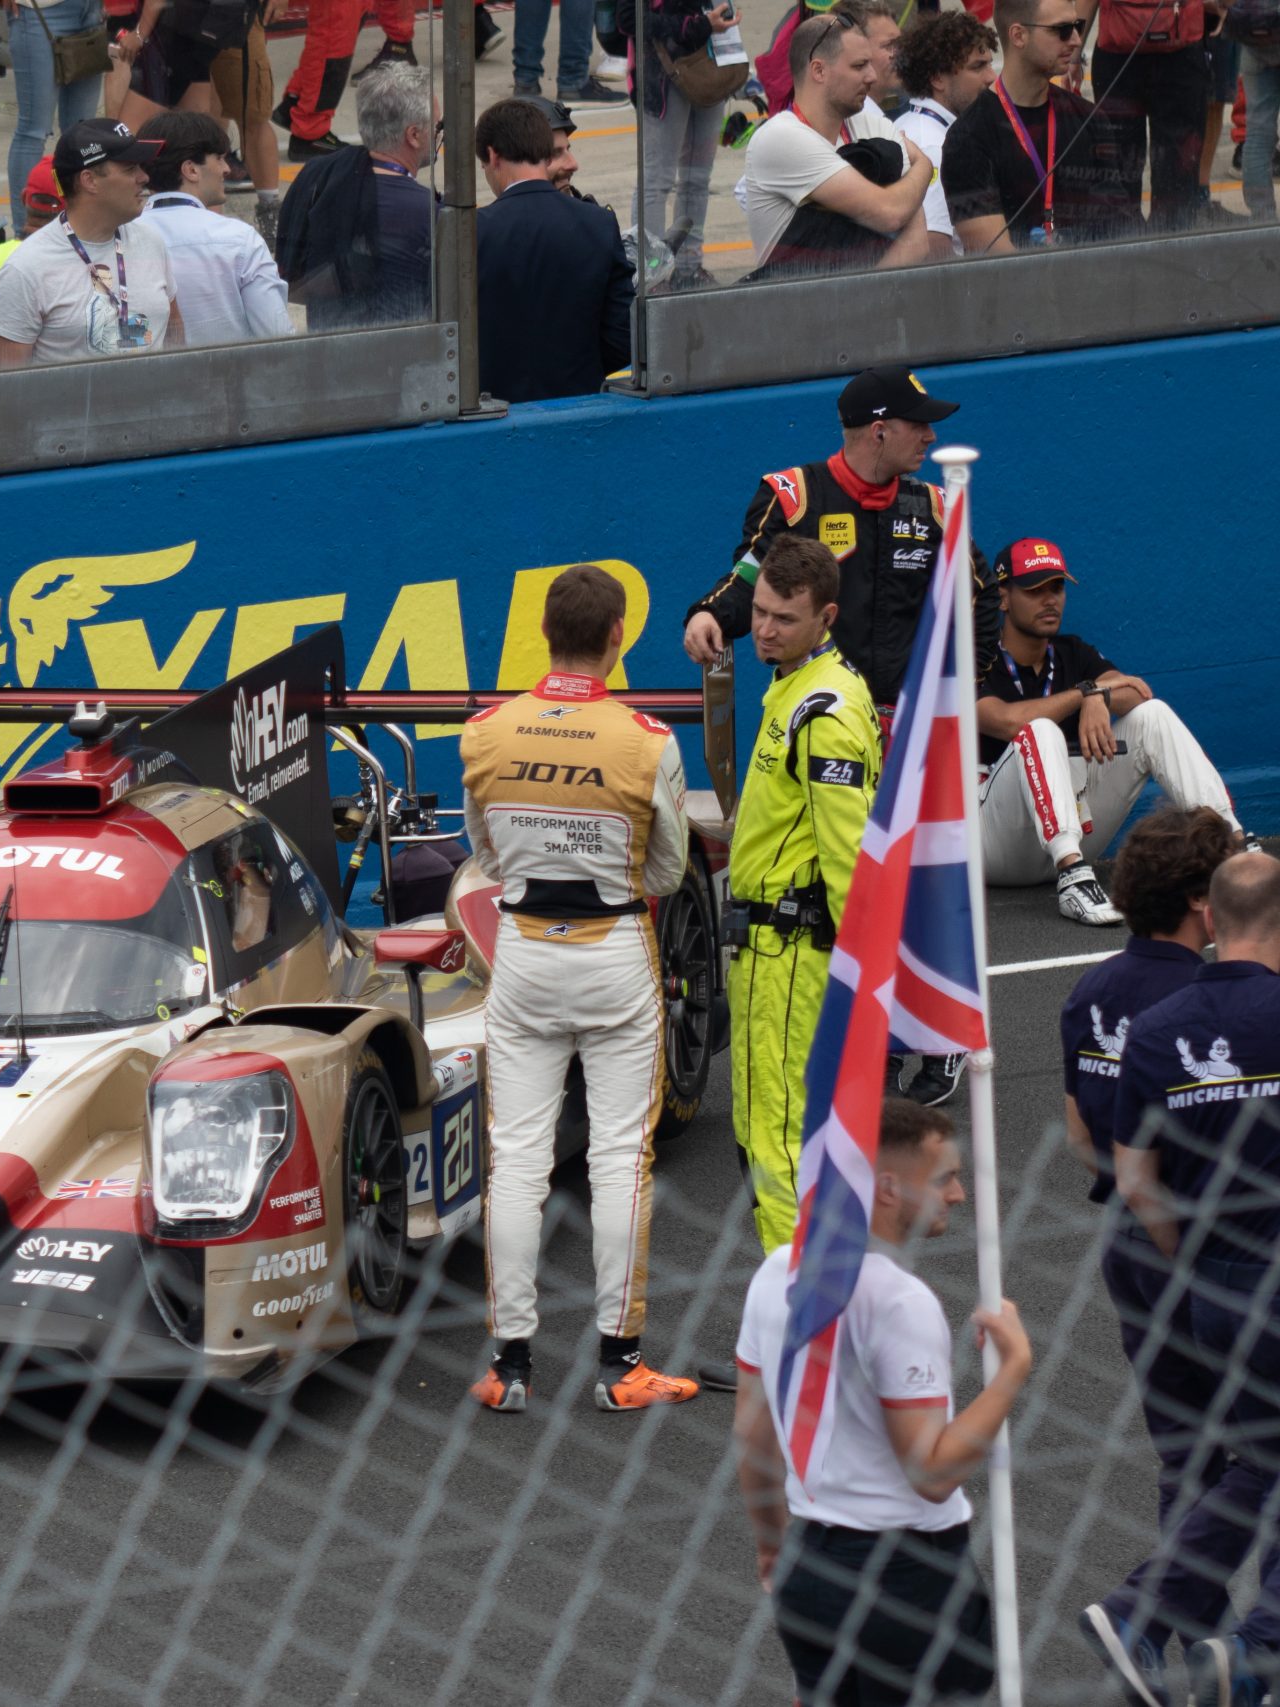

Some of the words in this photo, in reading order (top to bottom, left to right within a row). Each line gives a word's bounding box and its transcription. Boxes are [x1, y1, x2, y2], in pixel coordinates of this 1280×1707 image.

[825, 521, 849, 531] Hertz
[516, 726, 596, 741] RASMUSSEN
[497, 760, 605, 788] JOTA
[511, 815, 601, 832] PERFORMANCE
[566, 831, 602, 844] MADE
[544, 842, 602, 855] SMARTER
[1078, 1057, 1120, 1078] MICH
[1167, 1081, 1280, 1110] MICHELIN
[270, 1186, 320, 1210] PERFORMANCE
[293, 1209, 323, 1226] SMARTER
[55, 1240, 114, 1263] HEY
[252, 1241, 328, 1282] MOTUL
